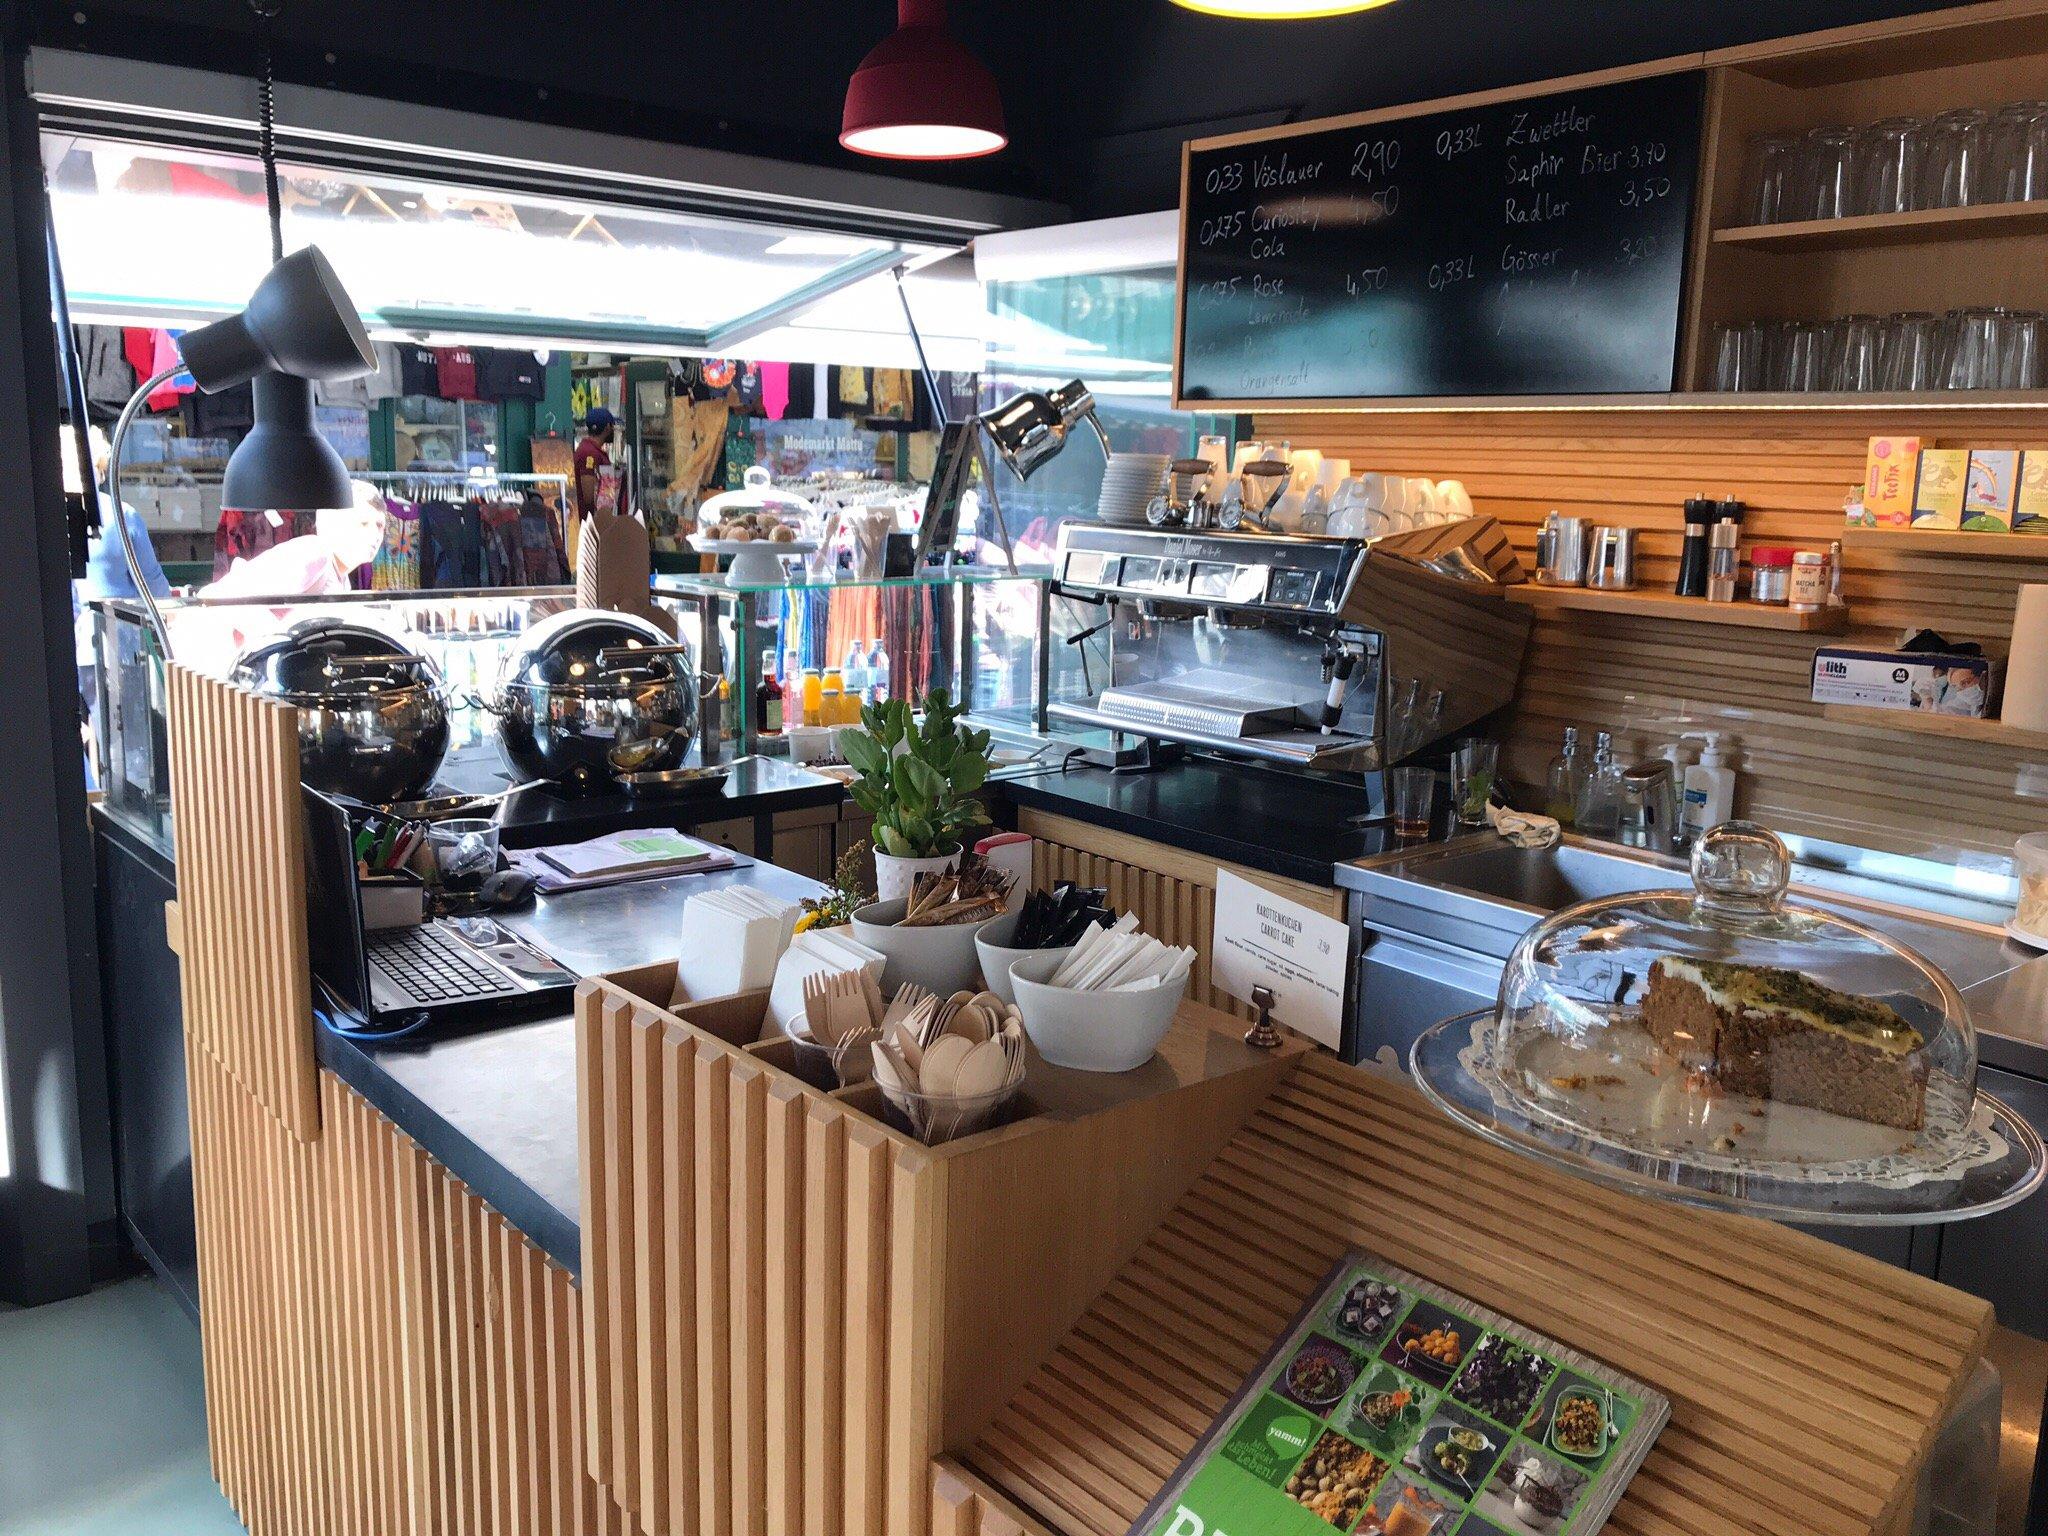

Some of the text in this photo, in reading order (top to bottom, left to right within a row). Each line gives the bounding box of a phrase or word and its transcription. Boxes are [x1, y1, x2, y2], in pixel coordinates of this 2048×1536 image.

[1505, 105, 1596, 147] Zwettler
[1206, 140, 1400, 194] 0,33 Vöslauer 2,90
[1504, 151, 1564, 188] Saphir
[1580, 144, 1622, 175] Bier
[1505, 192, 1571, 224] Radler
[1250, 236, 1285, 260] Cola
[1252, 274, 1285, 299] Rose
[1346, 266, 1389, 300] 4,50
[1261, 922, 1295, 948] CARROT CAKE
[1267, 1426, 1307, 1448] yamm!
